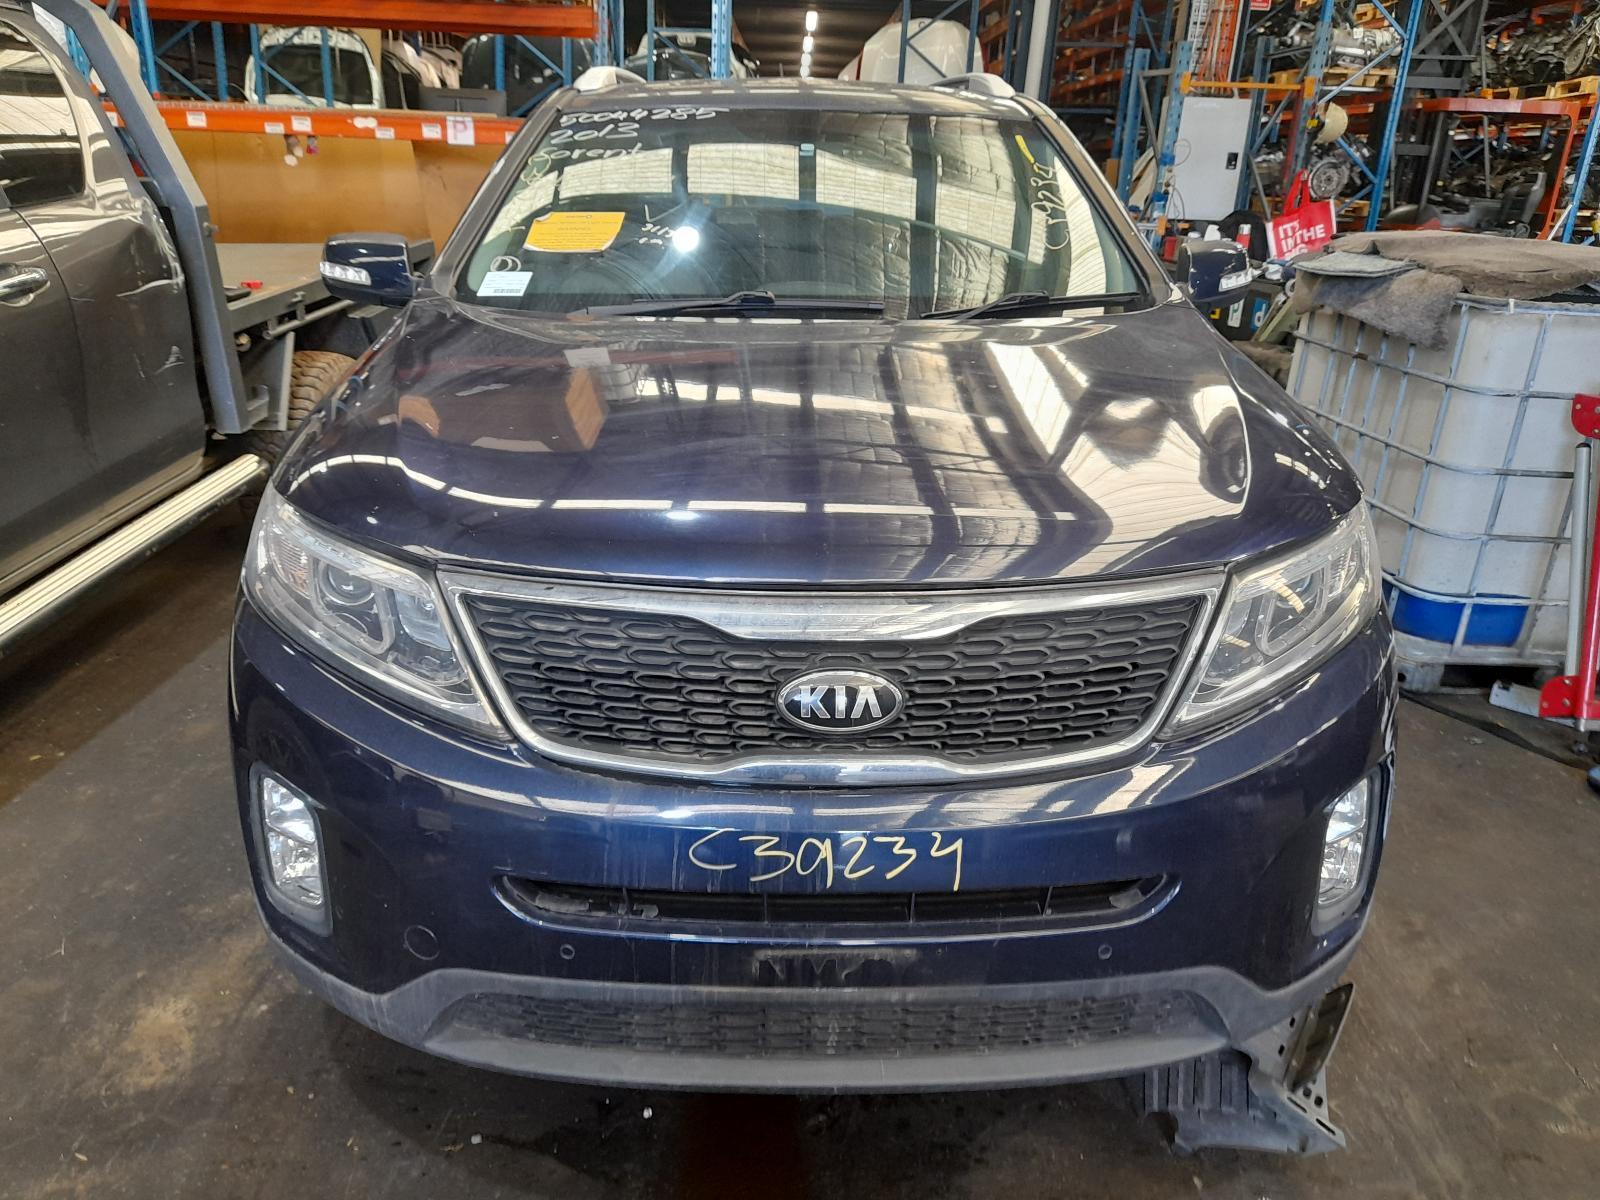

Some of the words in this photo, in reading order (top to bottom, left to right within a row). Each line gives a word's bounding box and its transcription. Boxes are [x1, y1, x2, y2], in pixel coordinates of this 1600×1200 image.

[550, 122, 640, 144] 2013
[1294, 223, 1326, 244] THE
[799, 685, 883, 719] KIA
[689, 828, 963, 892] C39234
